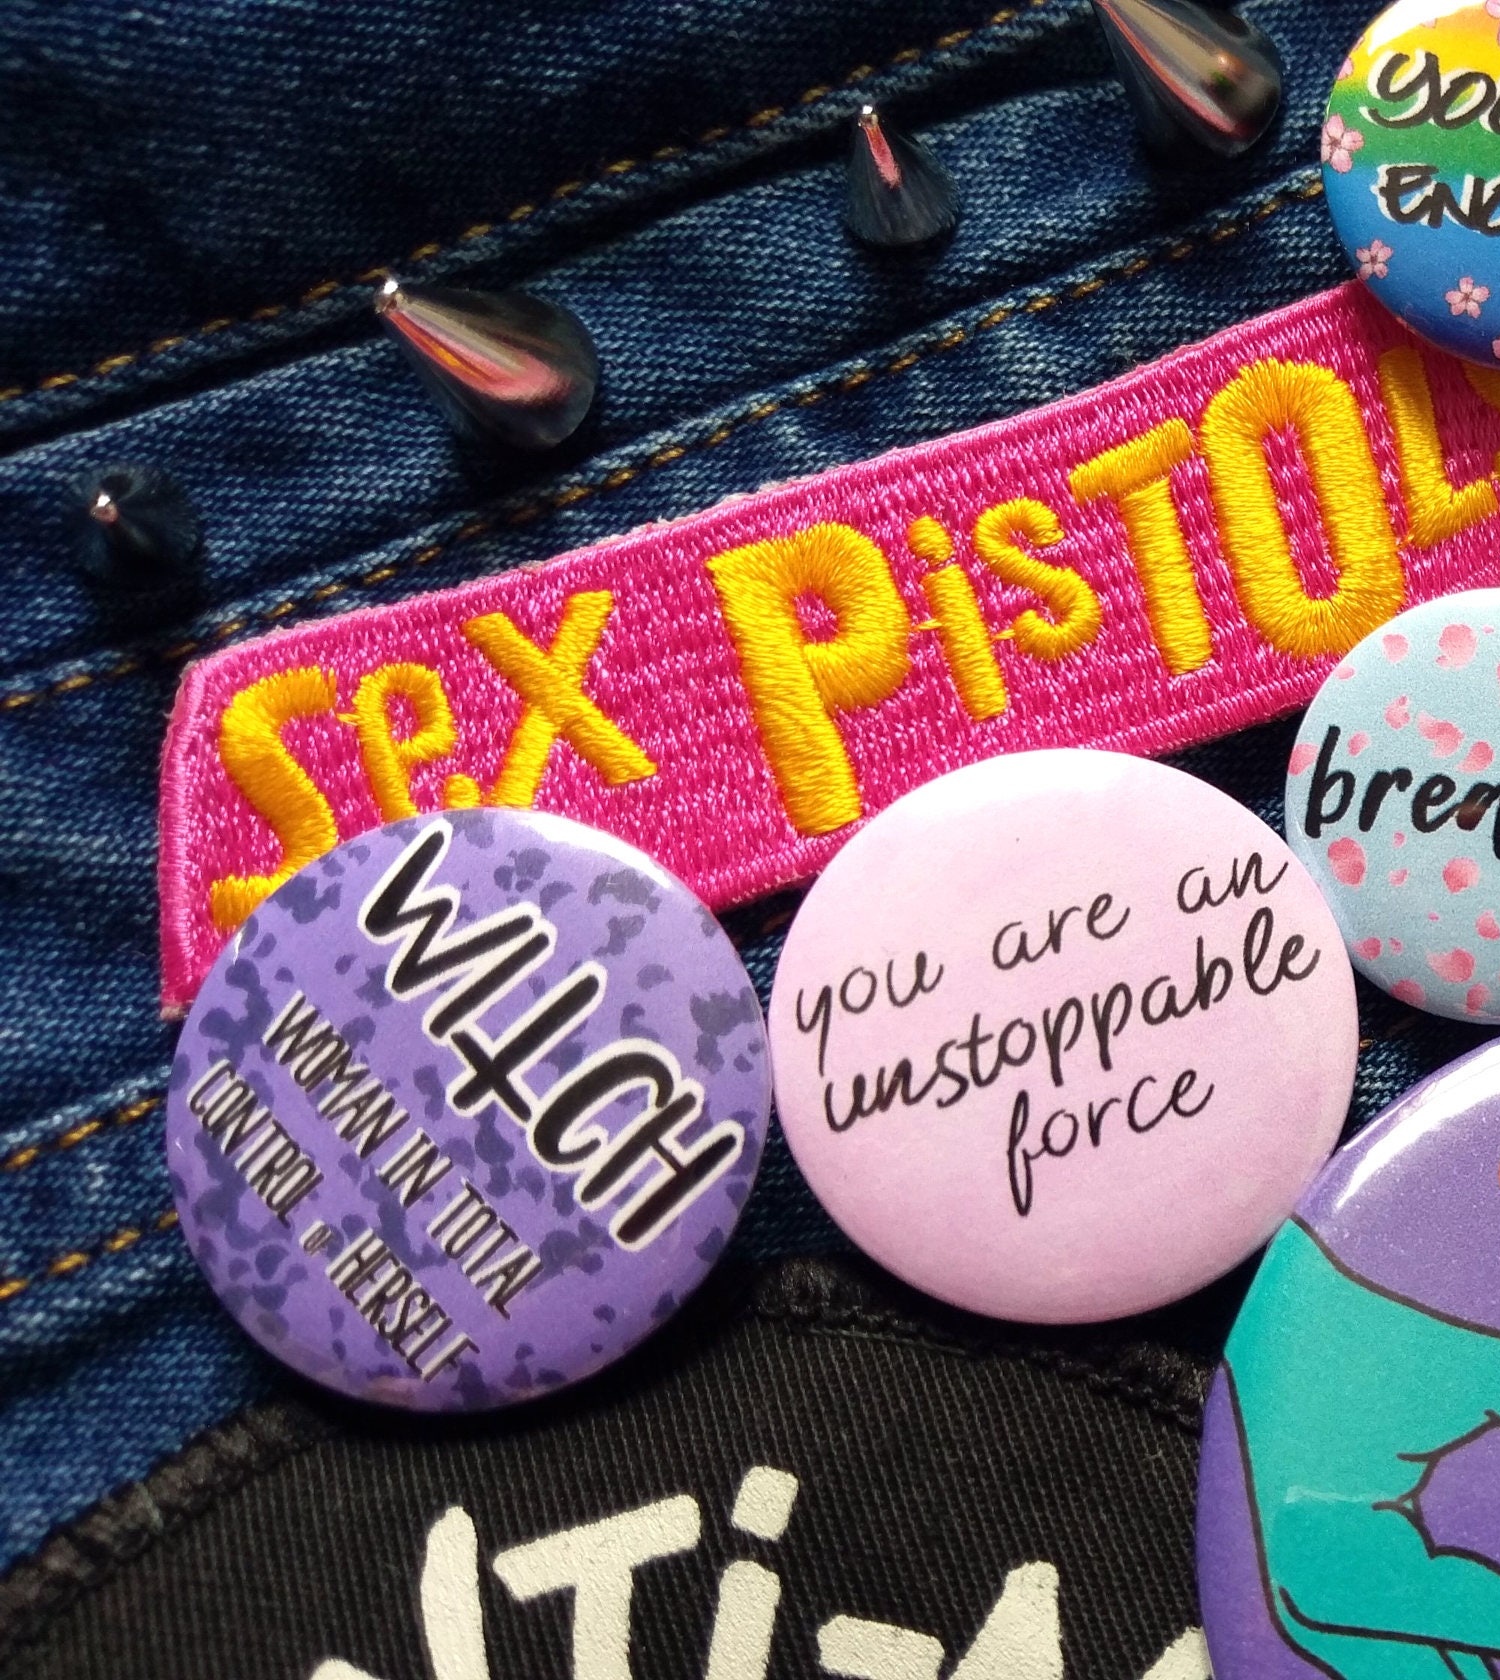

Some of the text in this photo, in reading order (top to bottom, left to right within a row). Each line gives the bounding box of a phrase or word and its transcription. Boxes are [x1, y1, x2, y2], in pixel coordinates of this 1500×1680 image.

[357, 818, 745, 1252] WITCH
[796, 852, 1289, 1076] you are an
[825, 906, 1321, 1132] unstoppable
[187, 1058, 482, 1384] CONTROL OF HERSELF
[261, 991, 545, 1320] WOMAN IN TOTAL
[1007, 1067, 1215, 1218] force
